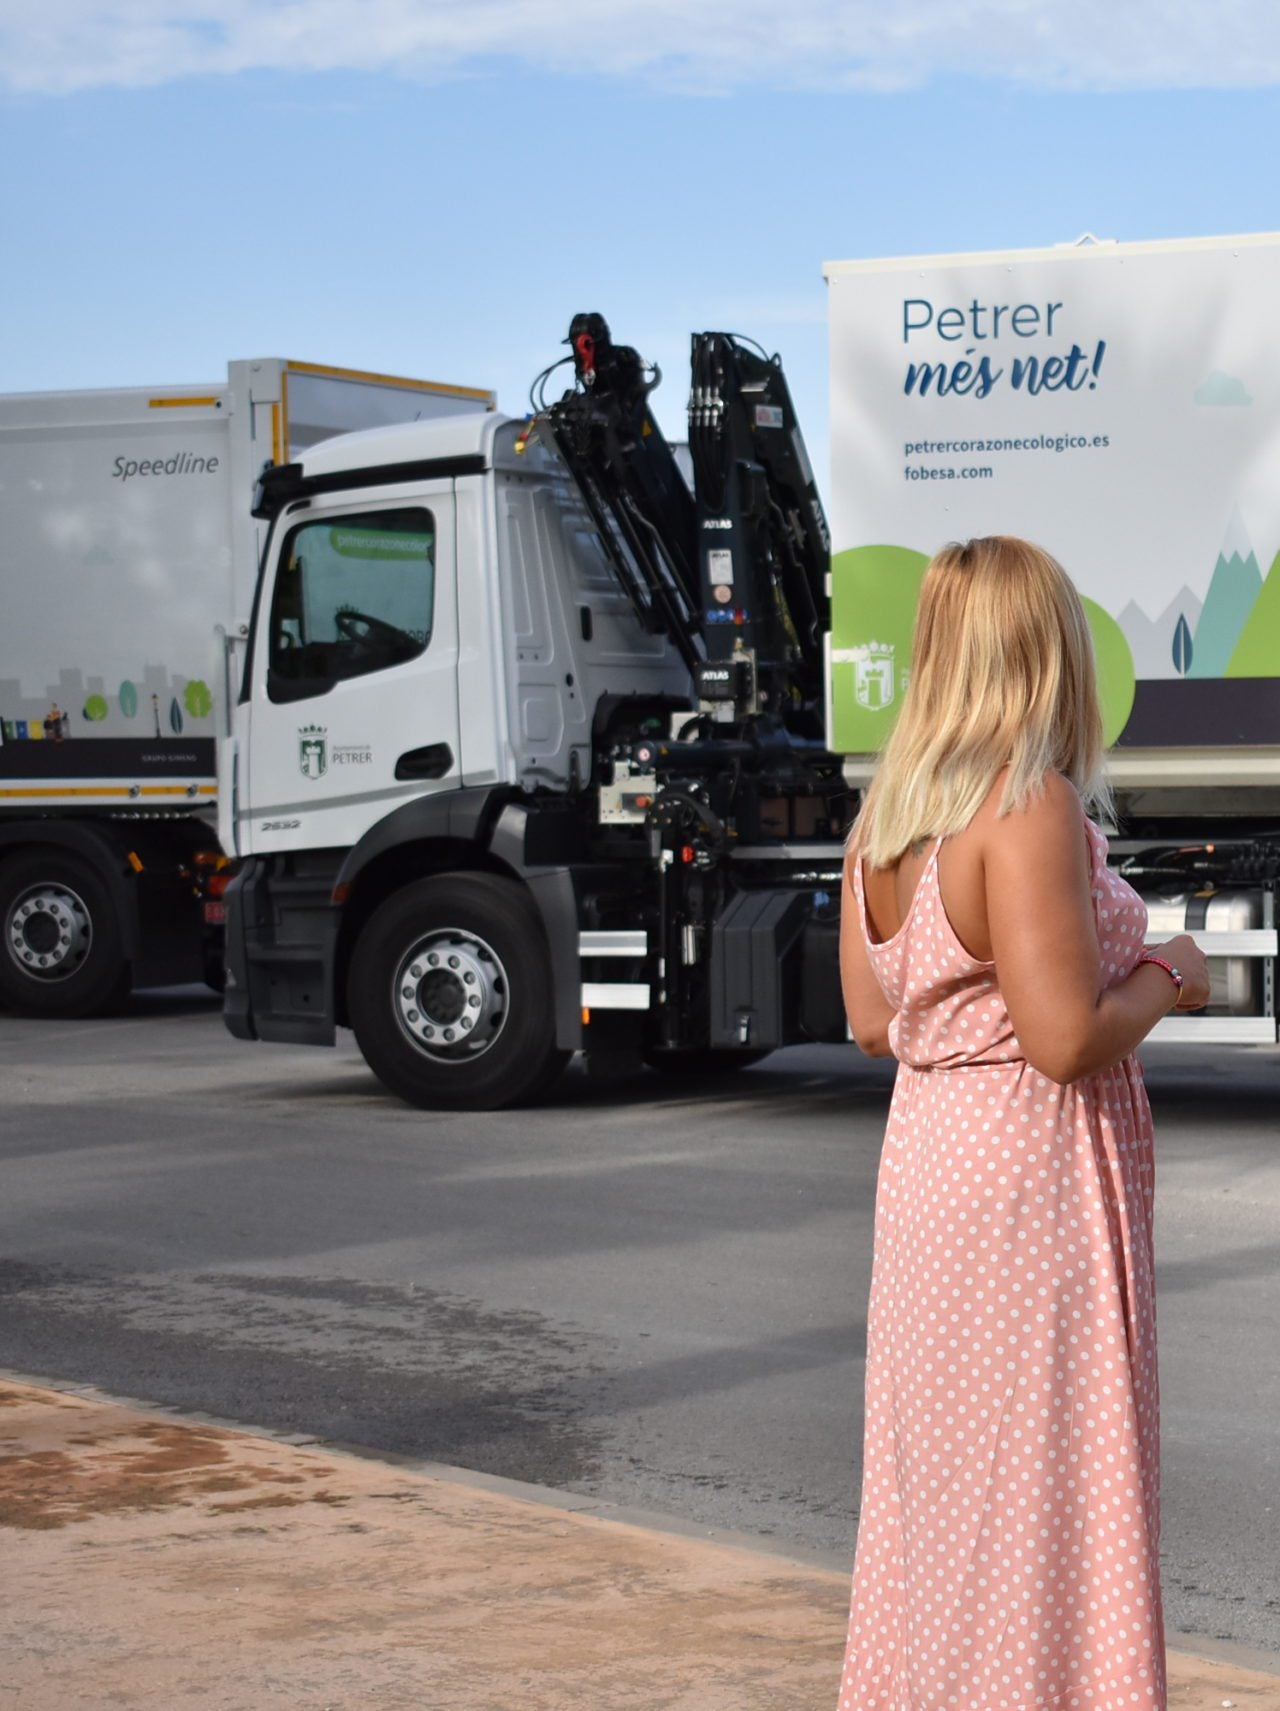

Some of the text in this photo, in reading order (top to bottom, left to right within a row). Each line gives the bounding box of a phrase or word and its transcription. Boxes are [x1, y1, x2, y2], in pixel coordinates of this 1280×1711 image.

[903, 299, 1063, 343] Petrer
[903, 340, 1106, 399] més net!
[904, 434, 1110, 457] petrercorazonecologico.es
[112, 452, 219, 482] Speedline
[904, 466, 993, 480] fobesa.com
[704, 519, 732, 529] ATLAS
[702, 670, 729, 681] ATLAS
[333, 753, 372, 764] PETRER
